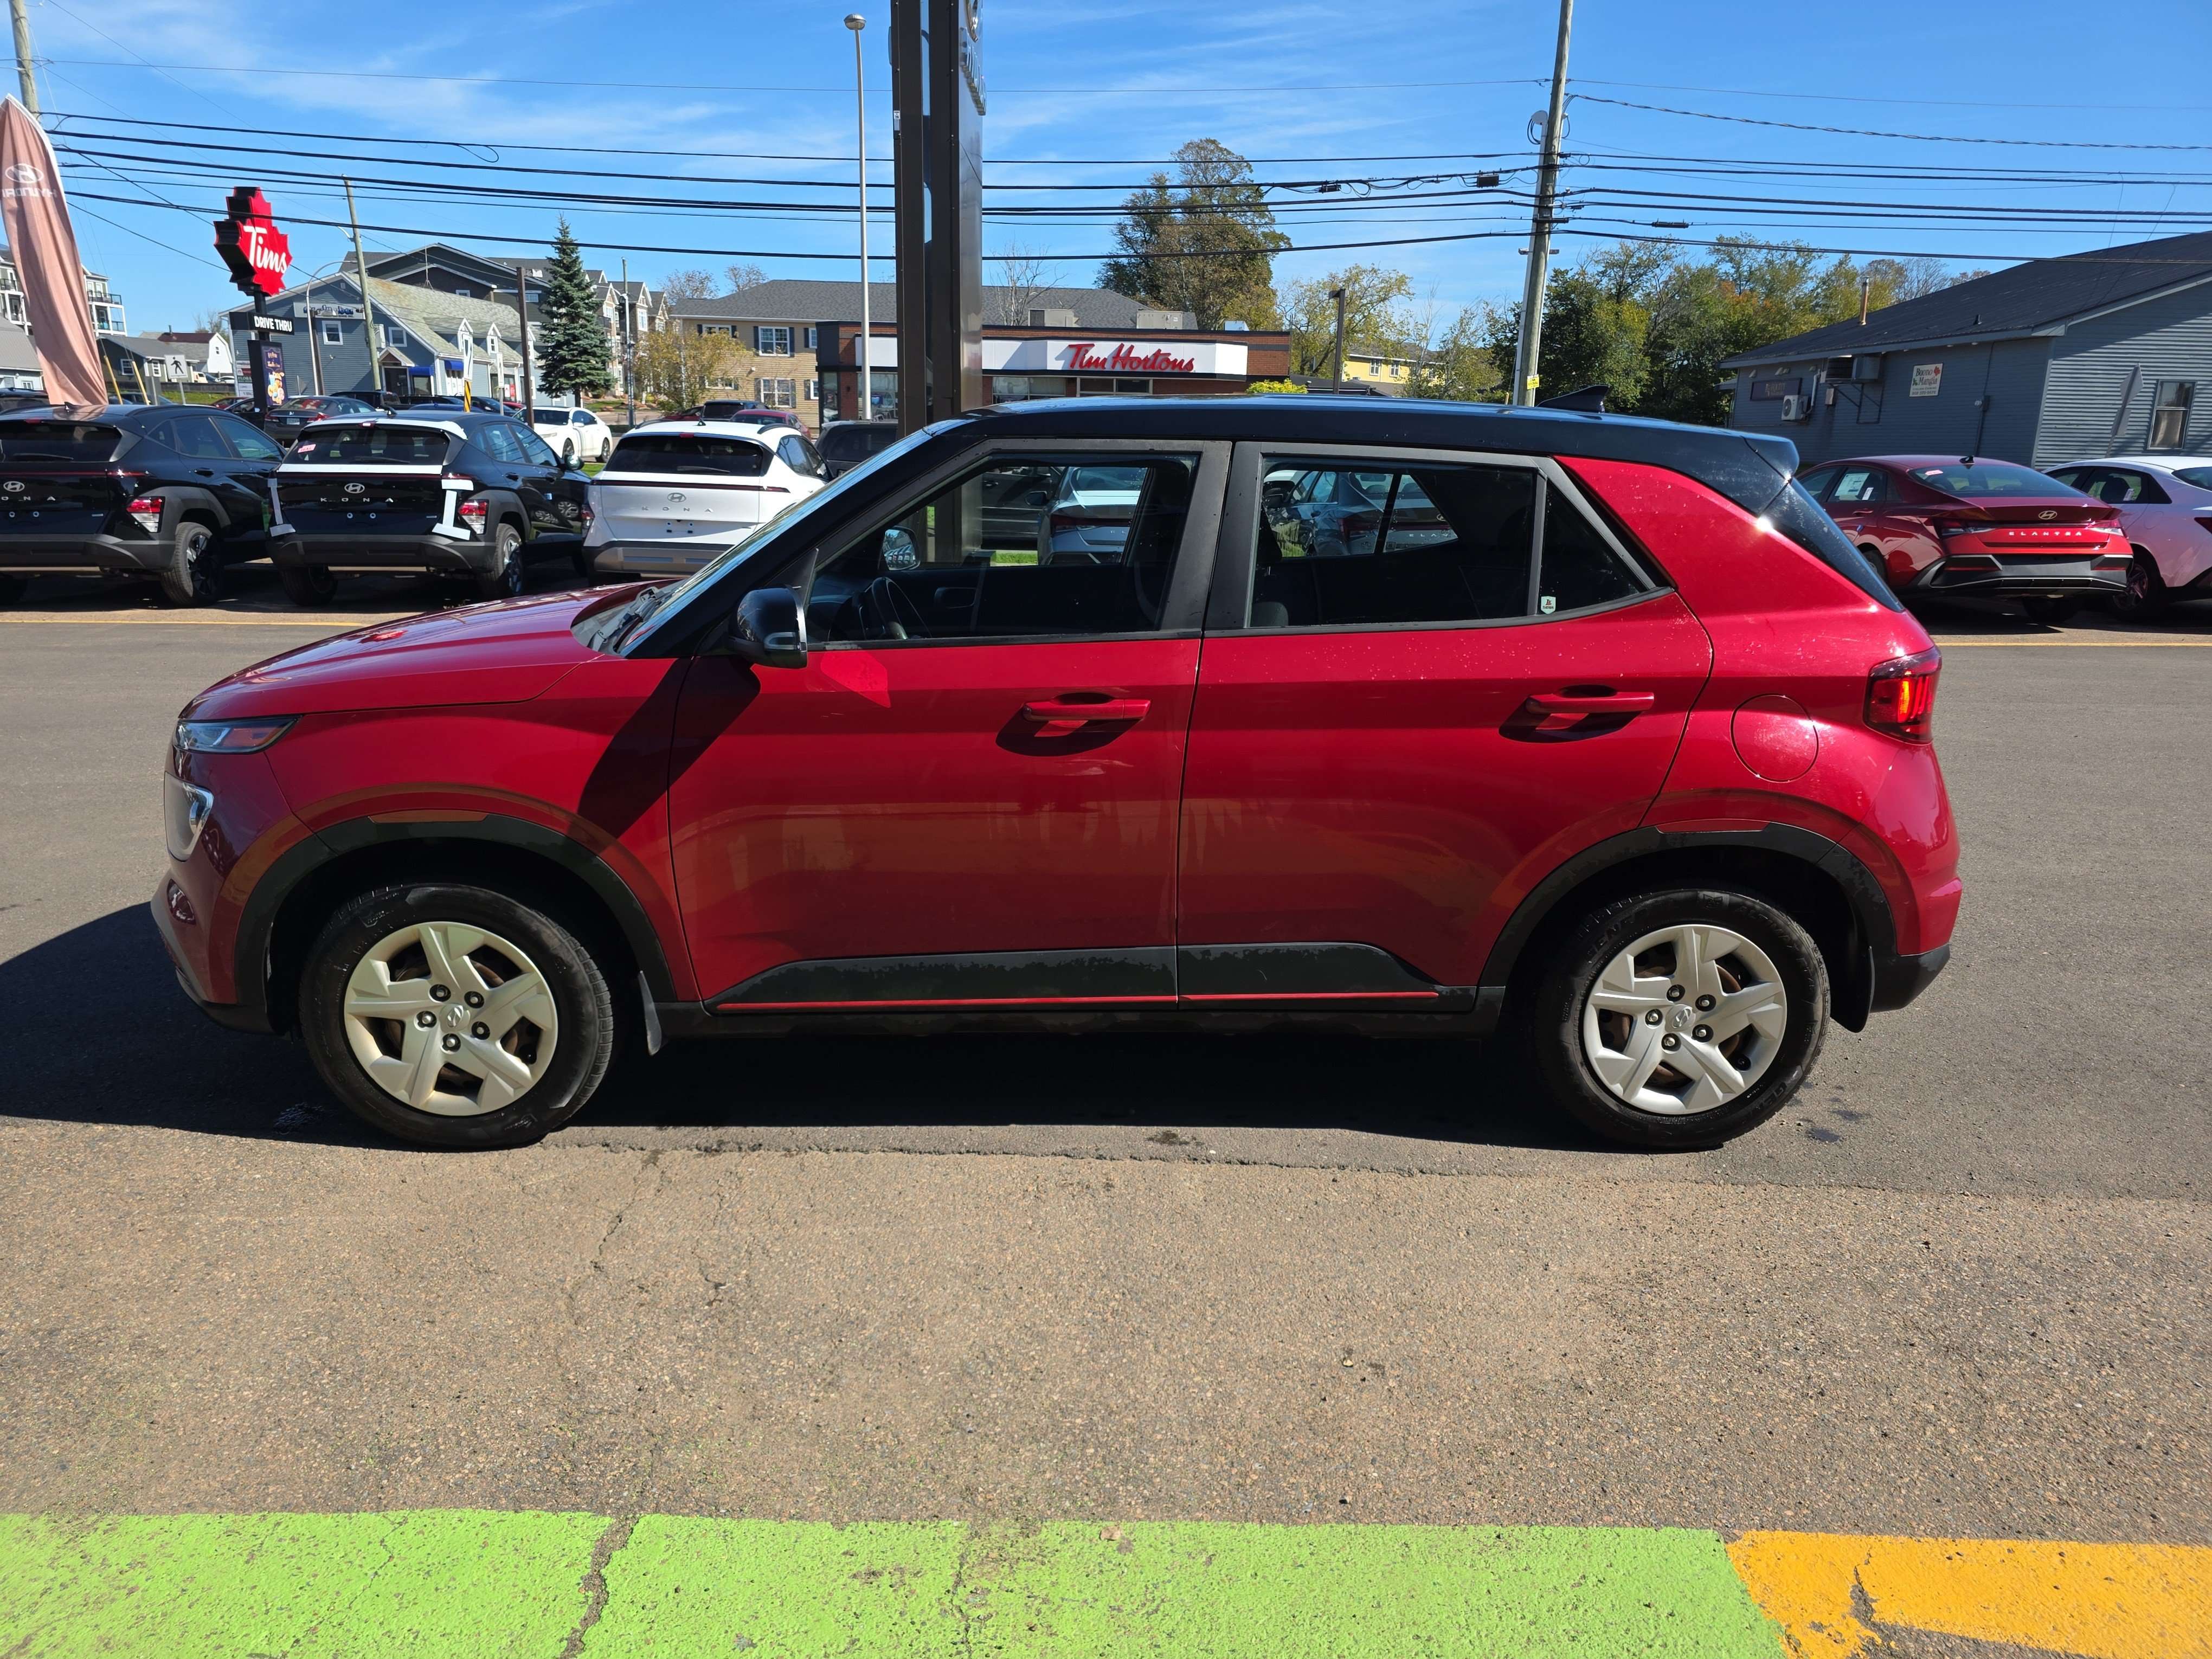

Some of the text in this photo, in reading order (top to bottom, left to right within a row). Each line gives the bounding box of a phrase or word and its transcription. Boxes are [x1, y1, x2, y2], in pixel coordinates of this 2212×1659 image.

[243, 225, 287, 274] Tims
[253, 316, 292, 332] DRIVE THRU
[1068, 343, 1194, 372] Tim Hortons
